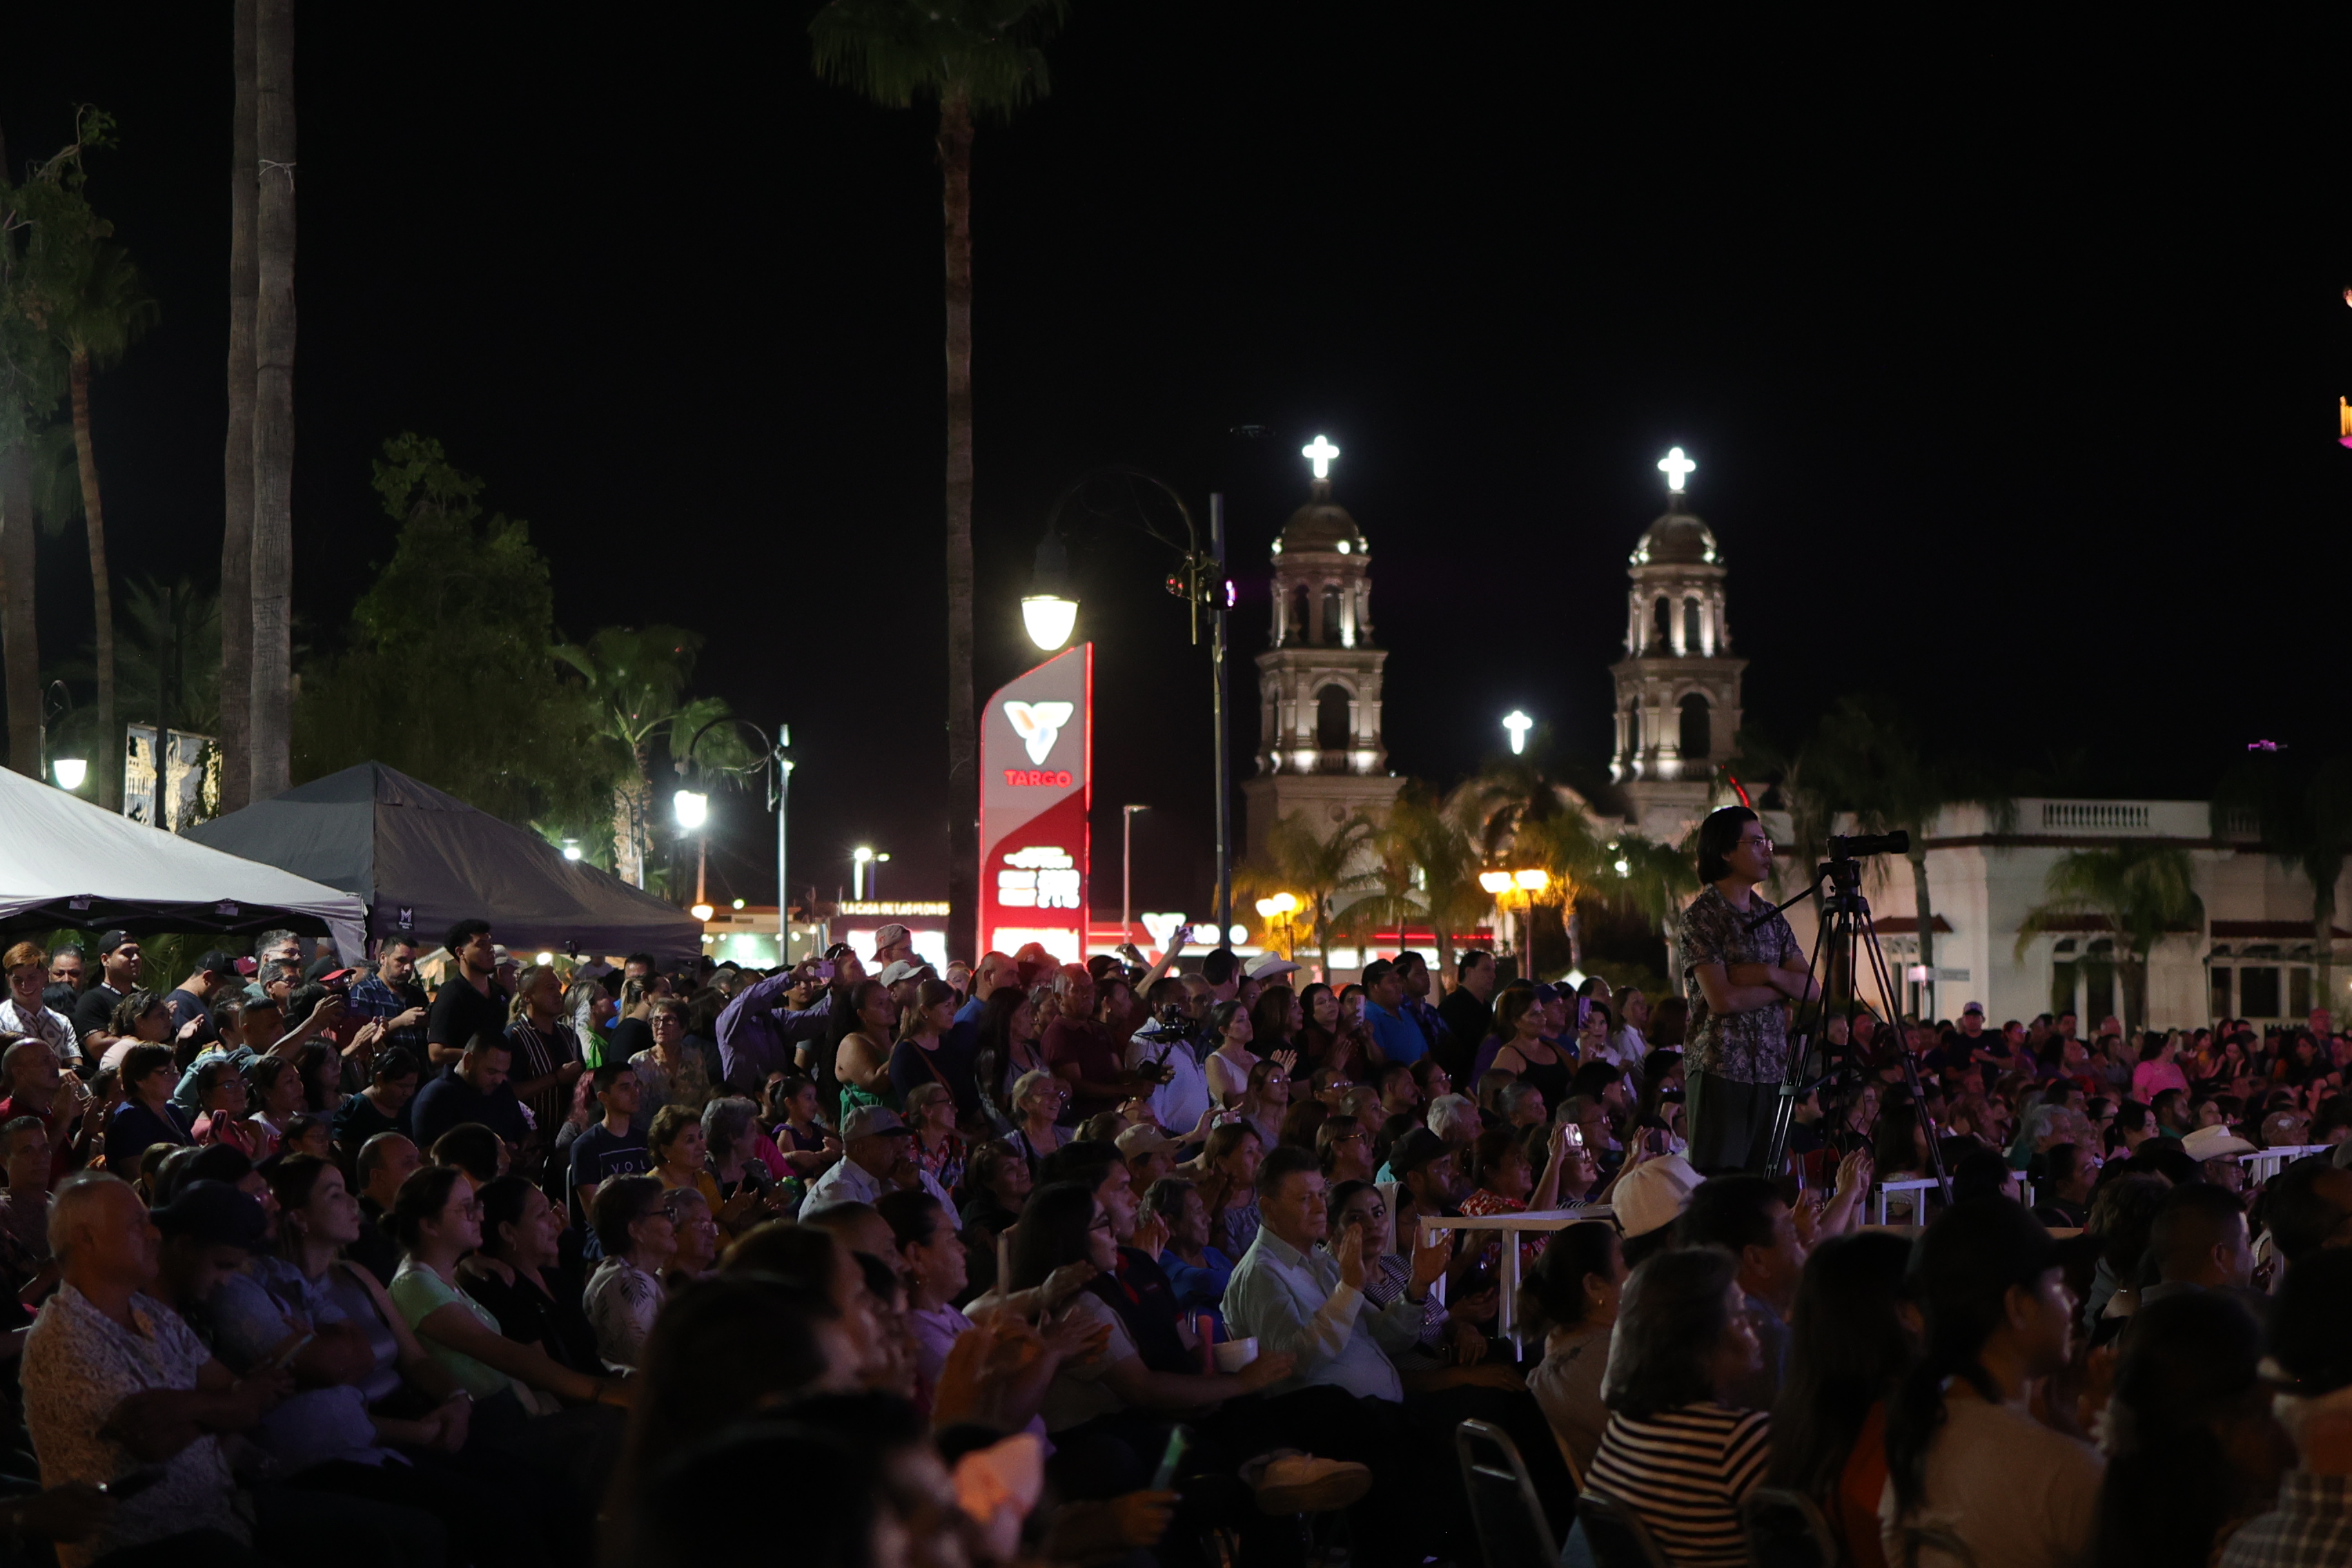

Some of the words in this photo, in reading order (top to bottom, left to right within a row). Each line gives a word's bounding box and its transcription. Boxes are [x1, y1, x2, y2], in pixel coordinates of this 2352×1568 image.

[1003, 769, 1072, 788] TARGO
[841, 901, 855, 915] LA
[855, 901, 879, 915] CASA
[880, 901, 894, 916] DE
[894, 901, 912, 916] LAS
[912, 901, 950, 916] FLORES
